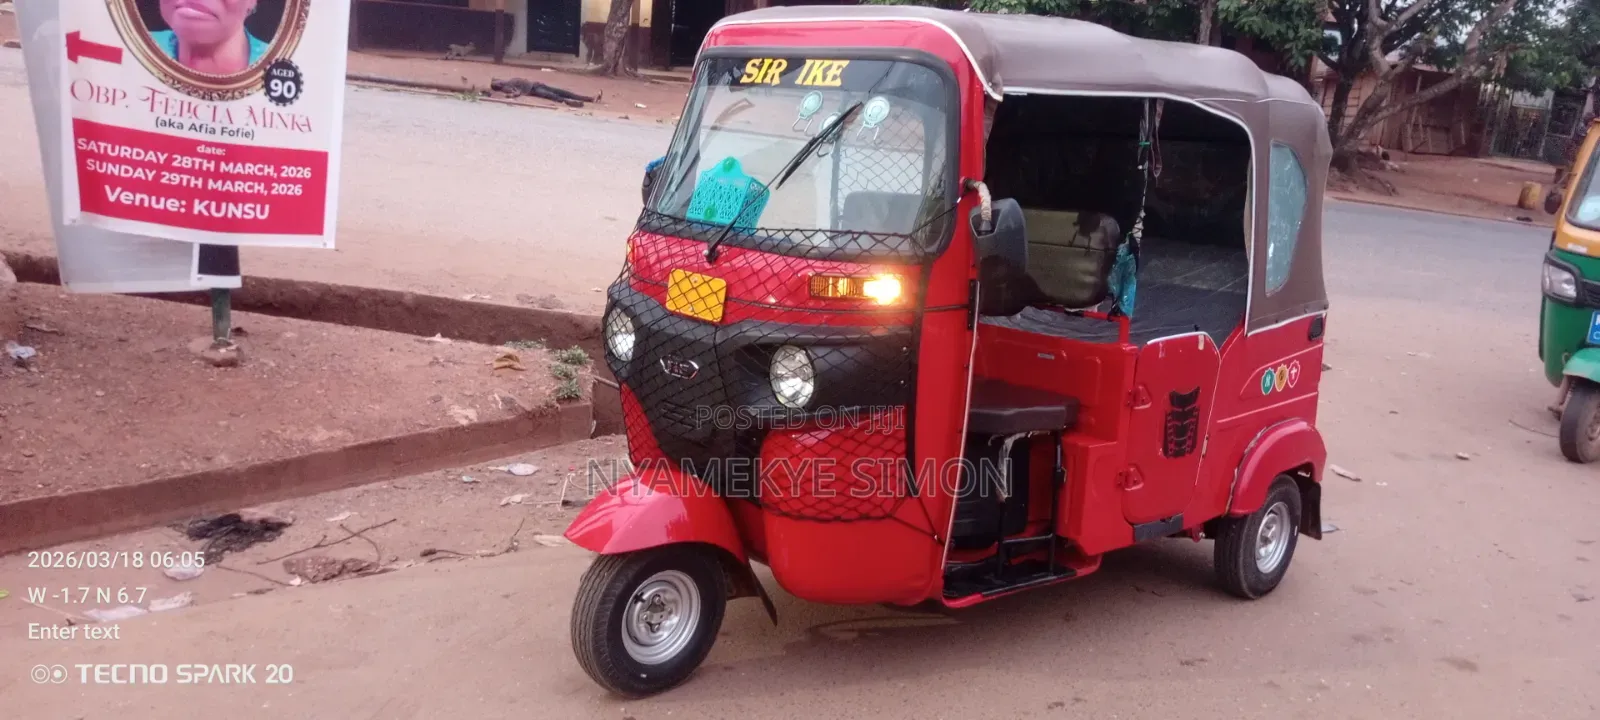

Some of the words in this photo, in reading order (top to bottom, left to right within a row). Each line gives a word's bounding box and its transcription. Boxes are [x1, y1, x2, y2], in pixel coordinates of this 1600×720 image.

[271, 68, 295, 78] AGED
[740, 58, 787, 86] SIR
[795, 59, 849, 86] IKE
[70, 78, 129, 108] OBP.
[269, 79, 296, 99] 90
[155, 117, 184, 130] (aka
[188, 122, 217, 135] Afia
[220, 127, 255, 140] Fofie)
[77, 138, 168, 164] SATURDAY
[171, 154, 215, 172] 28TH
[219, 161, 278, 179] MARCH,
[280, 165, 312, 179] 2026
[196, 144, 226, 156] date:
[86, 158, 156, 181] SUNDAY
[160, 171, 203, 189] 29TH
[207, 178, 268, 196] MARCH,
[270, 182, 303, 196] 2026
[104, 184, 187, 213] Venue:
[193, 198, 270, 220] KUNSU
